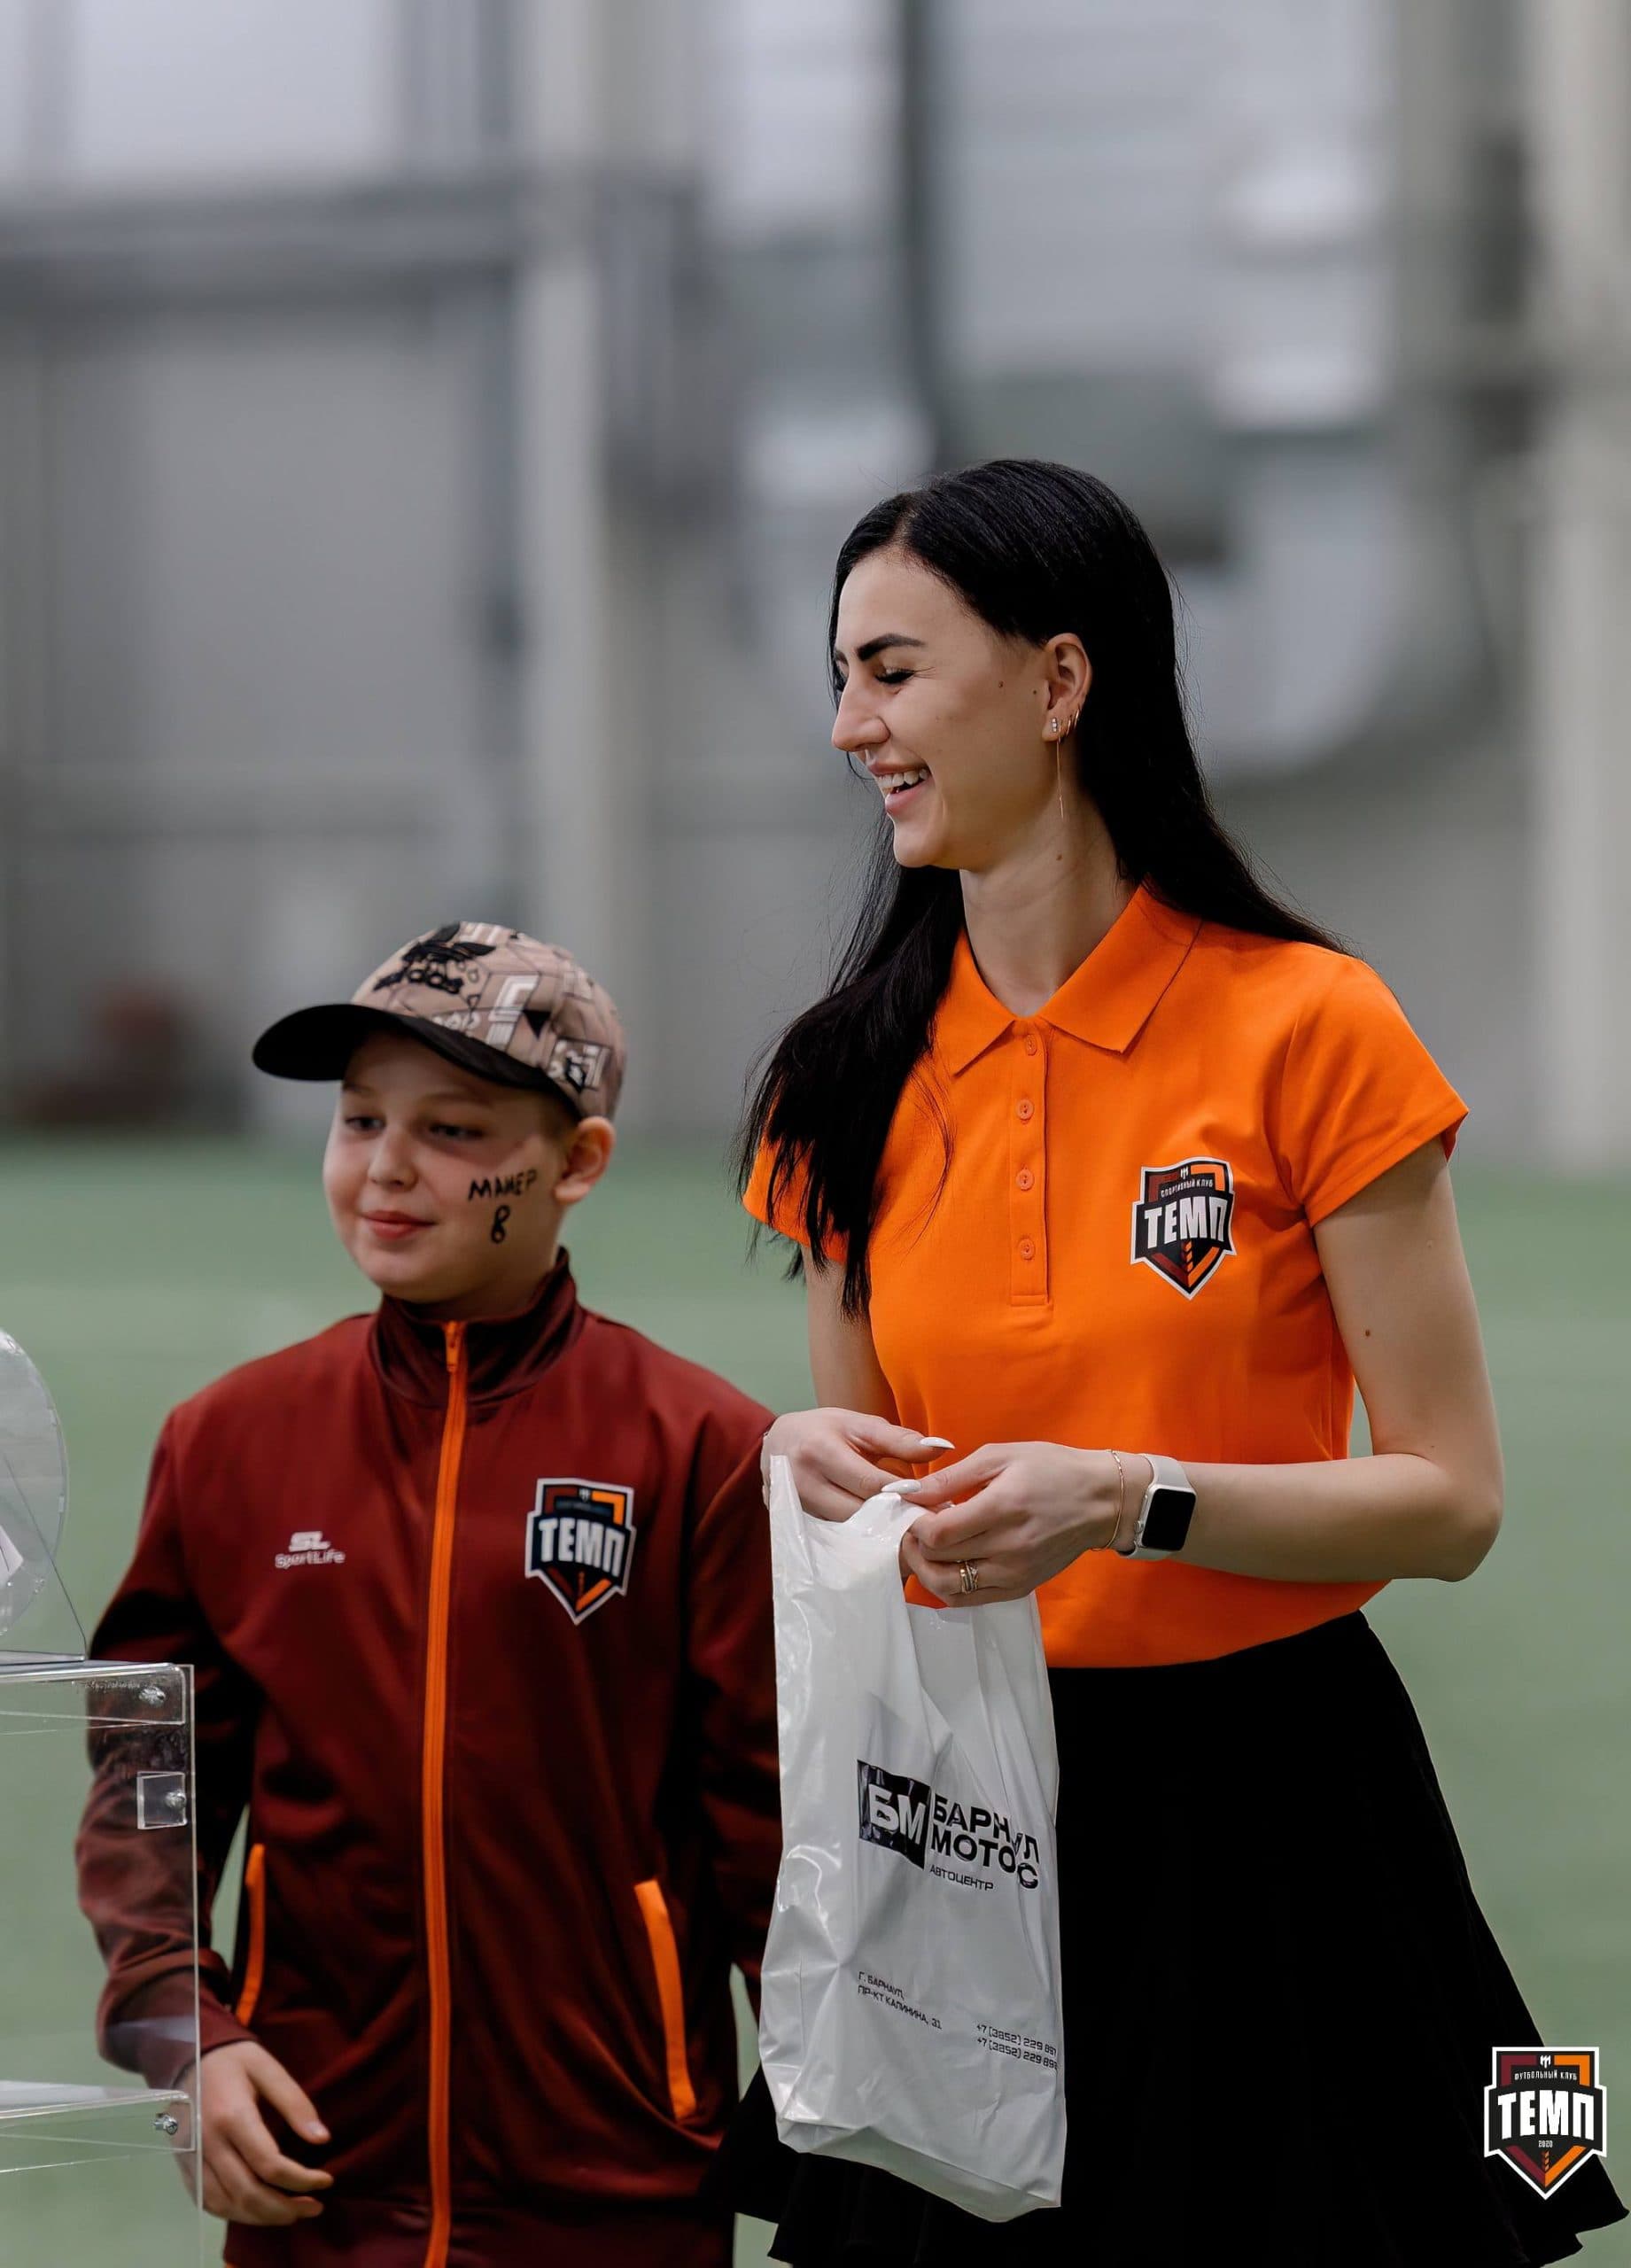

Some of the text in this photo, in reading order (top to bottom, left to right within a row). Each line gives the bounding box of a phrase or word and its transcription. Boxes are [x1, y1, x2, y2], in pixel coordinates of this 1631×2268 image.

[1196, 1178, 1214, 1188] КЛУБ
[491, 1205, 510, 1244] 8
[1145, 1196, 1229, 1249] ТЕМП
[539, 1517, 625, 1578] ТЕМП
[868, 1783, 927, 1845] БМ
[933, 1793, 1040, 1864] БАРНУЛ
[930, 1864, 994, 1891] АВТОЦЕНТР
[931, 2017, 943, 2030] 31
[976, 2023, 987, 2033] +7
[1023, 2038, 1043, 2050] 229
[977, 2037, 987, 2047] +7
[1023, 2051, 1041, 2064] 229
